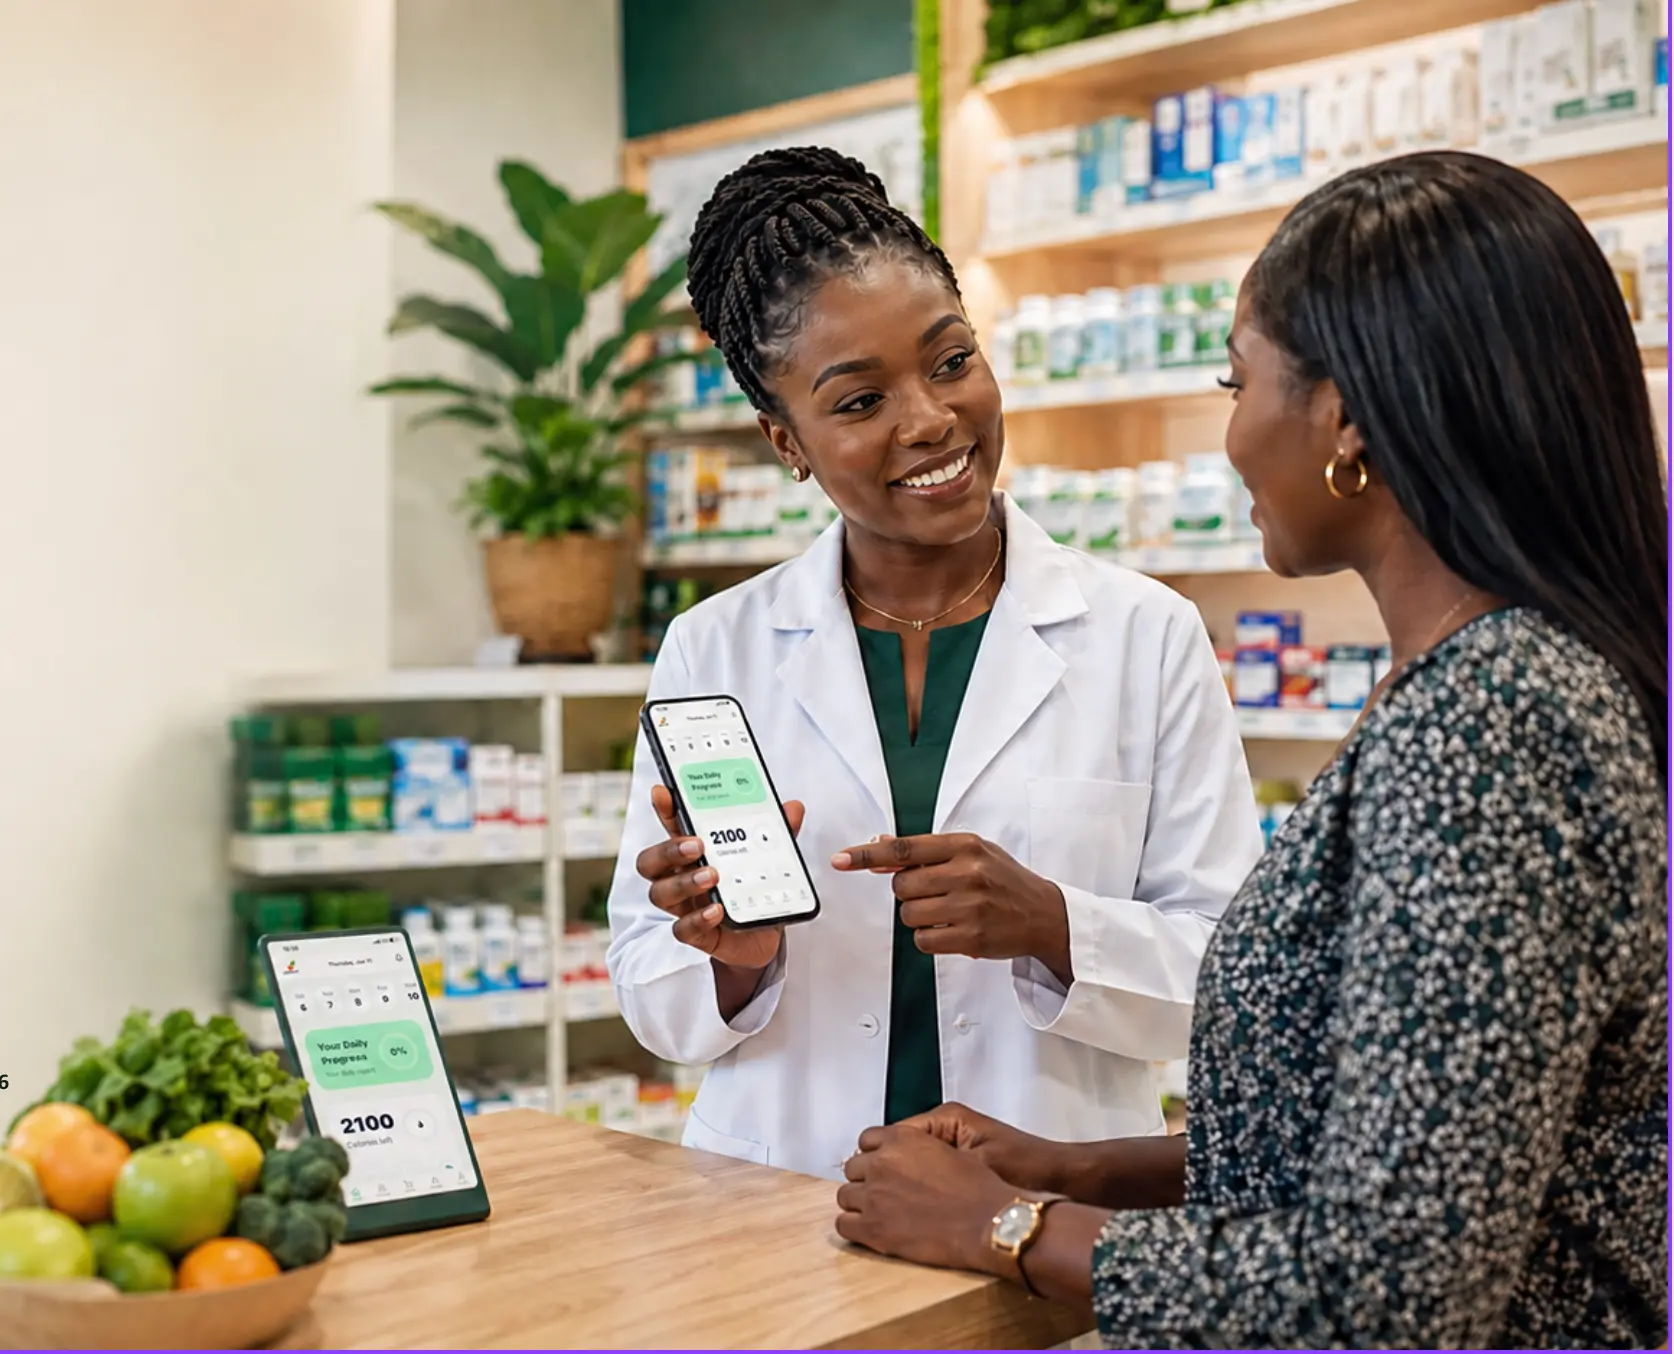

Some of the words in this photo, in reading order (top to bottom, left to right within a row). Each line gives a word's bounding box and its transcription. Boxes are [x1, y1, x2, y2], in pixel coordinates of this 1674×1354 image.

[709, 828, 747, 845] 2100
[407, 992, 420, 1001] 10
[342, 1039, 369, 1050] Daily
[390, 1046, 408, 1057] 0%
[340, 1113, 394, 1134] 2100
